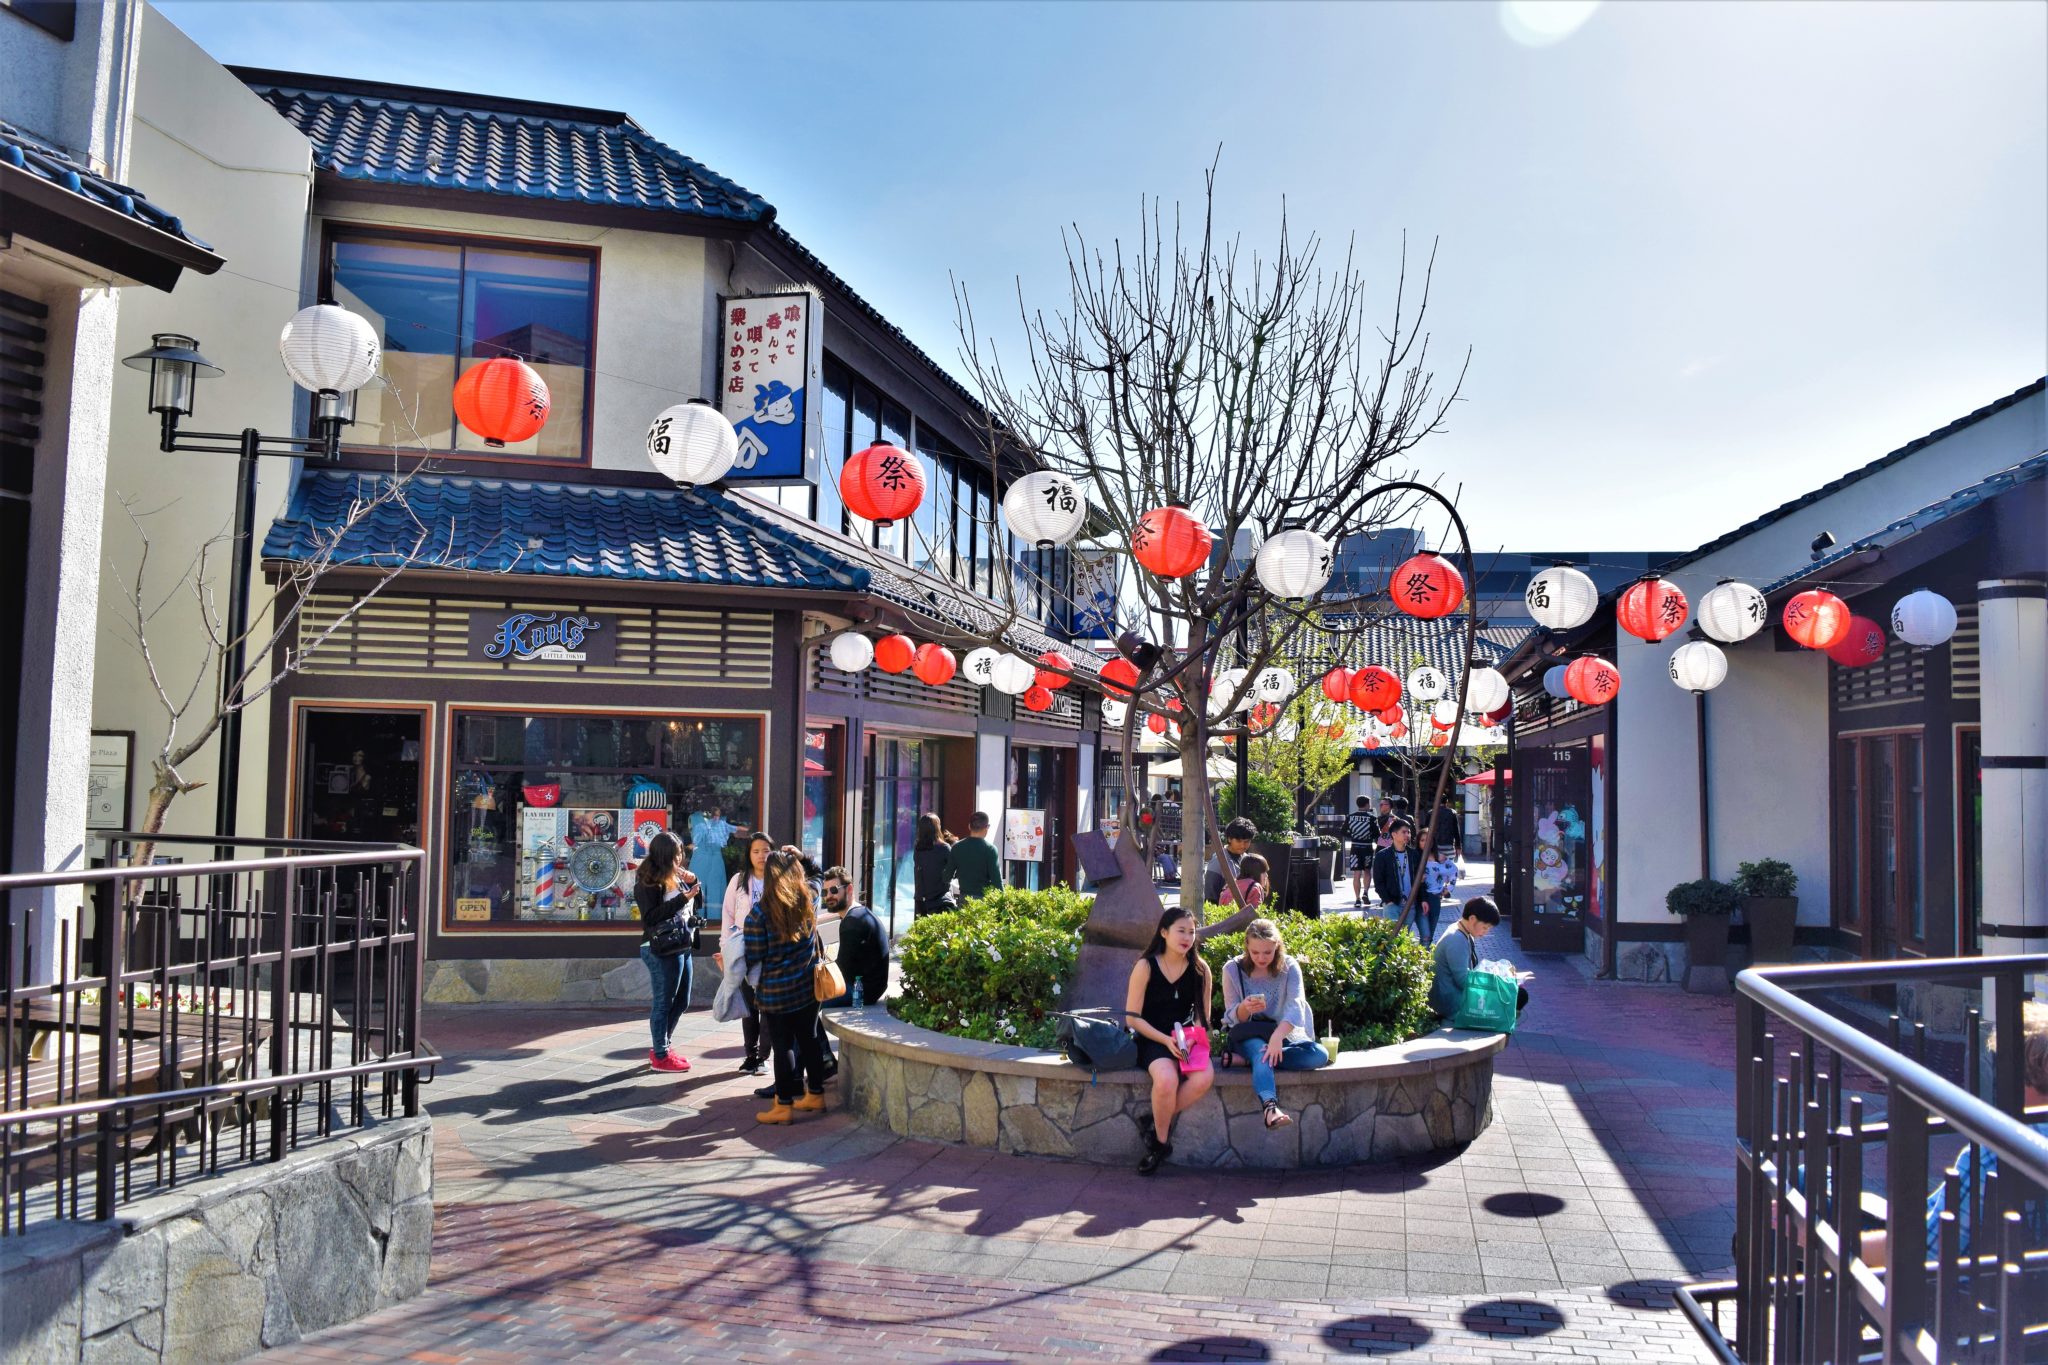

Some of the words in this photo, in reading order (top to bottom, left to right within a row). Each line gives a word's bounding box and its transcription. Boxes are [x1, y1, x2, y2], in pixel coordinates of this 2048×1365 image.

[766, 312, 782, 364] 呑んで
[648, 417, 673, 455] 福
[874, 456, 915, 491] 祭
[1041, 478, 1077, 514] 福
[1402, 573, 1438, 604] 祭
[1527, 580, 1550, 609] 福
[1657, 595, 1685, 624] 祭
[1787, 601, 1806, 626] 祭
[484, 612, 600, 658] Kools
[1262, 674, 1280, 690] 福
[1363, 672, 1384, 692] 祭
[1417, 673, 1436, 689] 福
[1594, 669, 1615, 693] 祭
[1553, 751, 1571, 761] 115
[460, 904, 487, 912] OPEN
